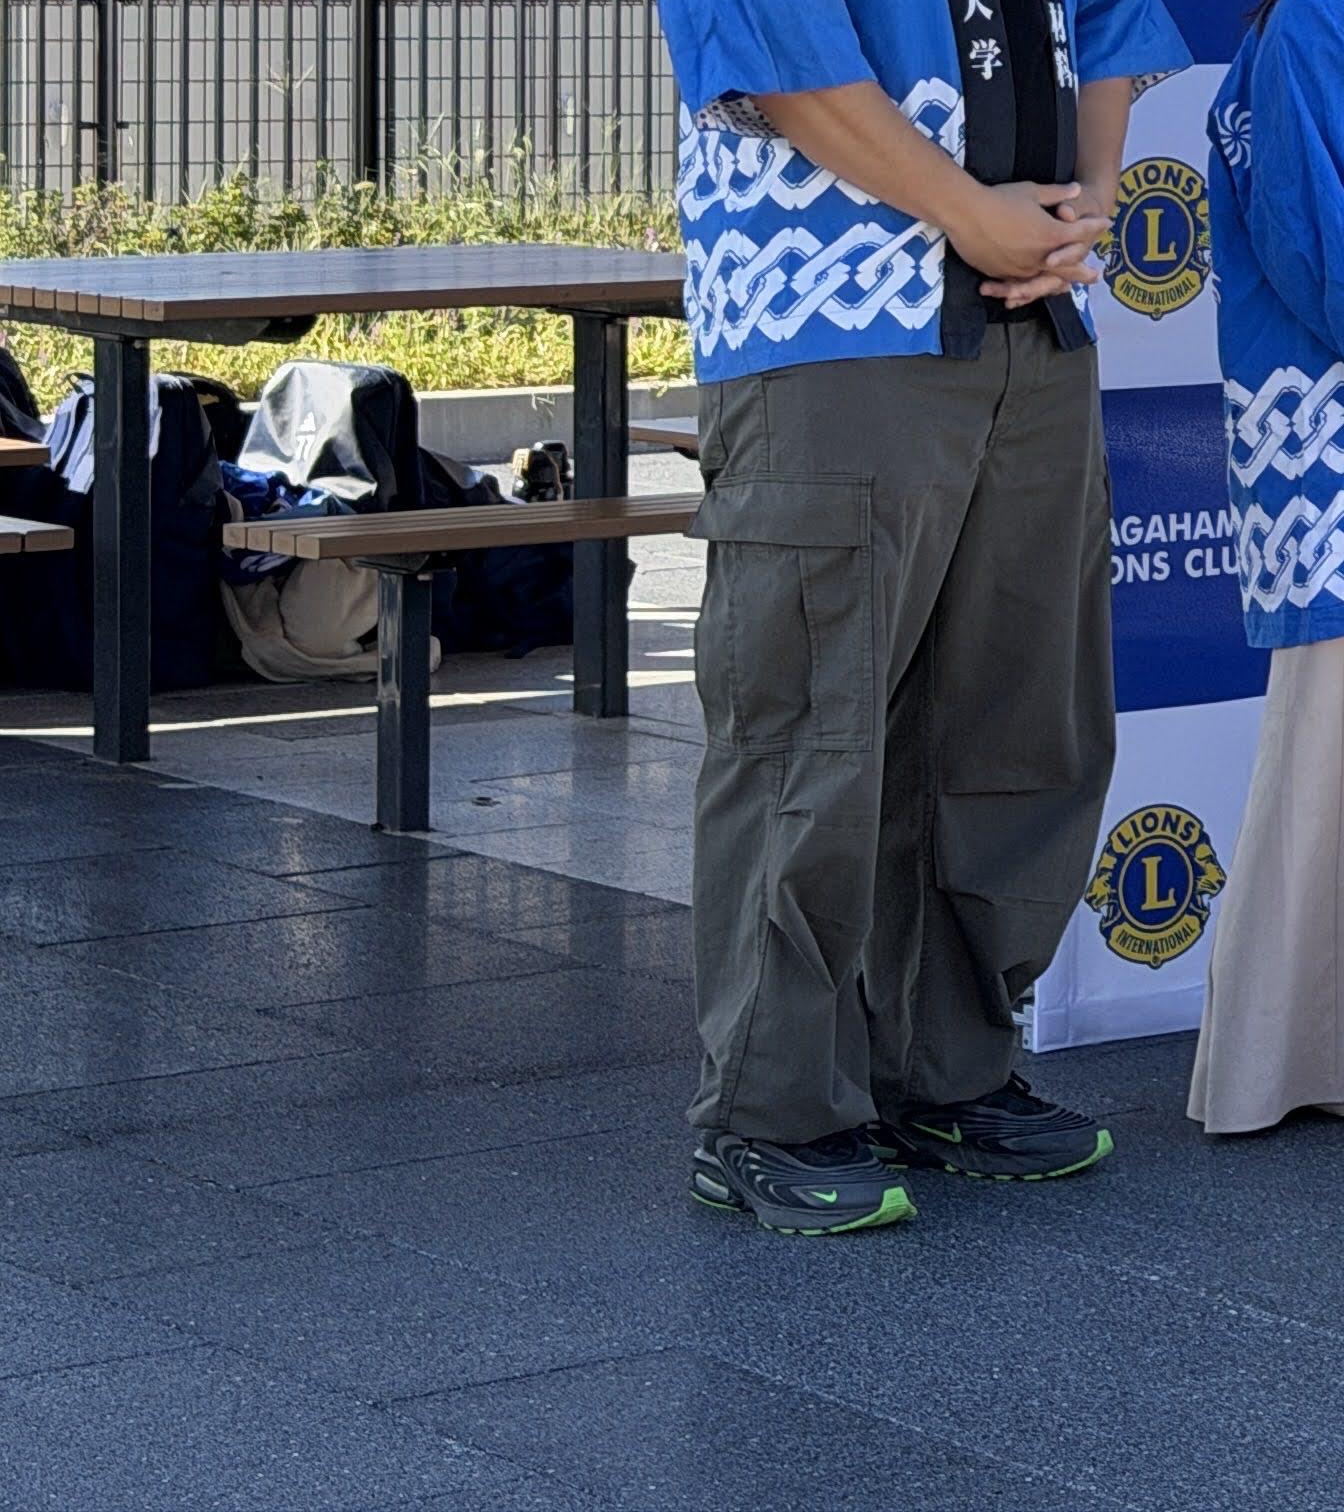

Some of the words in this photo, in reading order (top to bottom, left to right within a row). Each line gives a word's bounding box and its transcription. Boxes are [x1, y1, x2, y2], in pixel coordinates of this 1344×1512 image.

[1120, 164, 1198, 199] LIONS
[1143, 208, 1177, 261] L
[1120, 277, 1196, 306] INTERNATIONAL
[1185, 546, 1240, 577] CLU
[1117, 811, 1196, 848] LIONS
[1141, 856, 1177, 911] L
[1115, 922, 1196, 955] INTERNATIONAL
